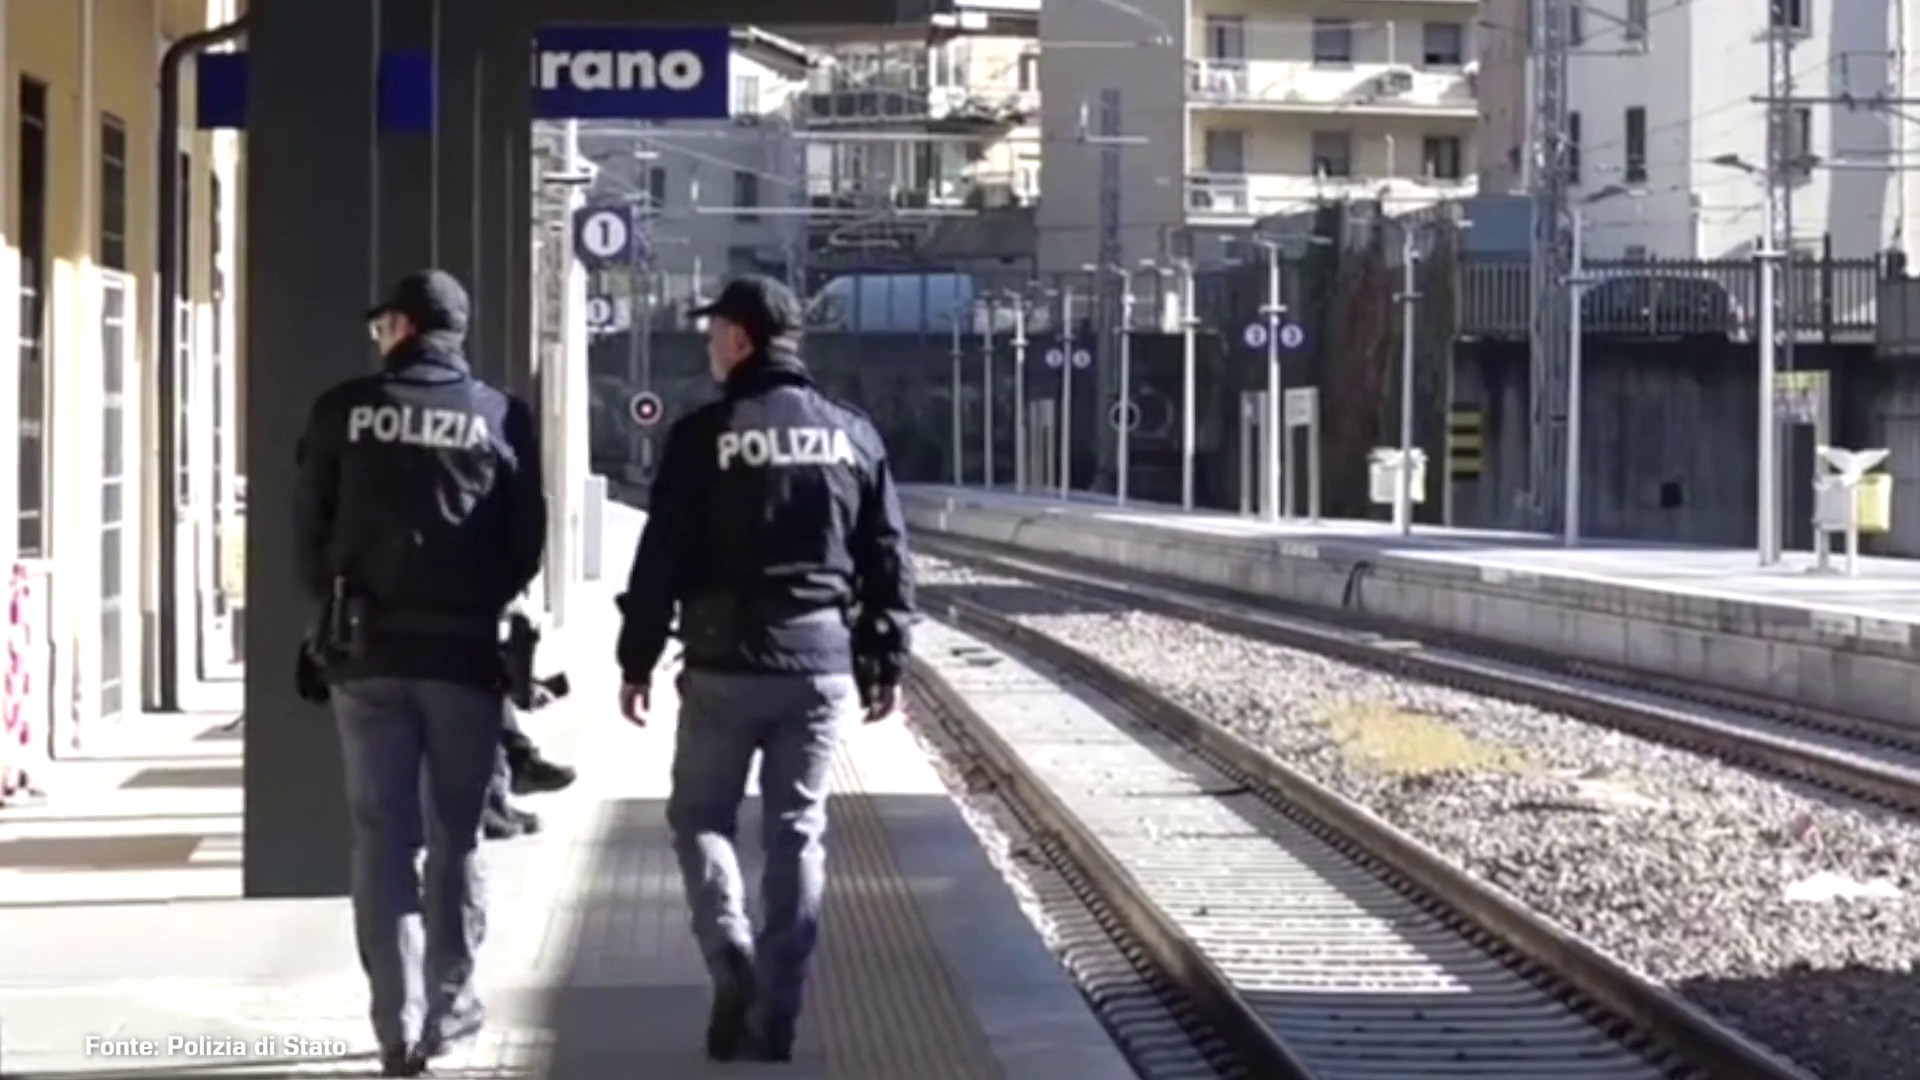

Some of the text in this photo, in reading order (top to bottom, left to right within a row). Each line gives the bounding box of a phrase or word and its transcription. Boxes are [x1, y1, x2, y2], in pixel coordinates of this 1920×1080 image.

[530, 39, 703, 91] rano
[598, 220, 609, 248] 1
[348, 405, 490, 452] POLIZIA
[717, 427, 856, 470] POLIZIA
